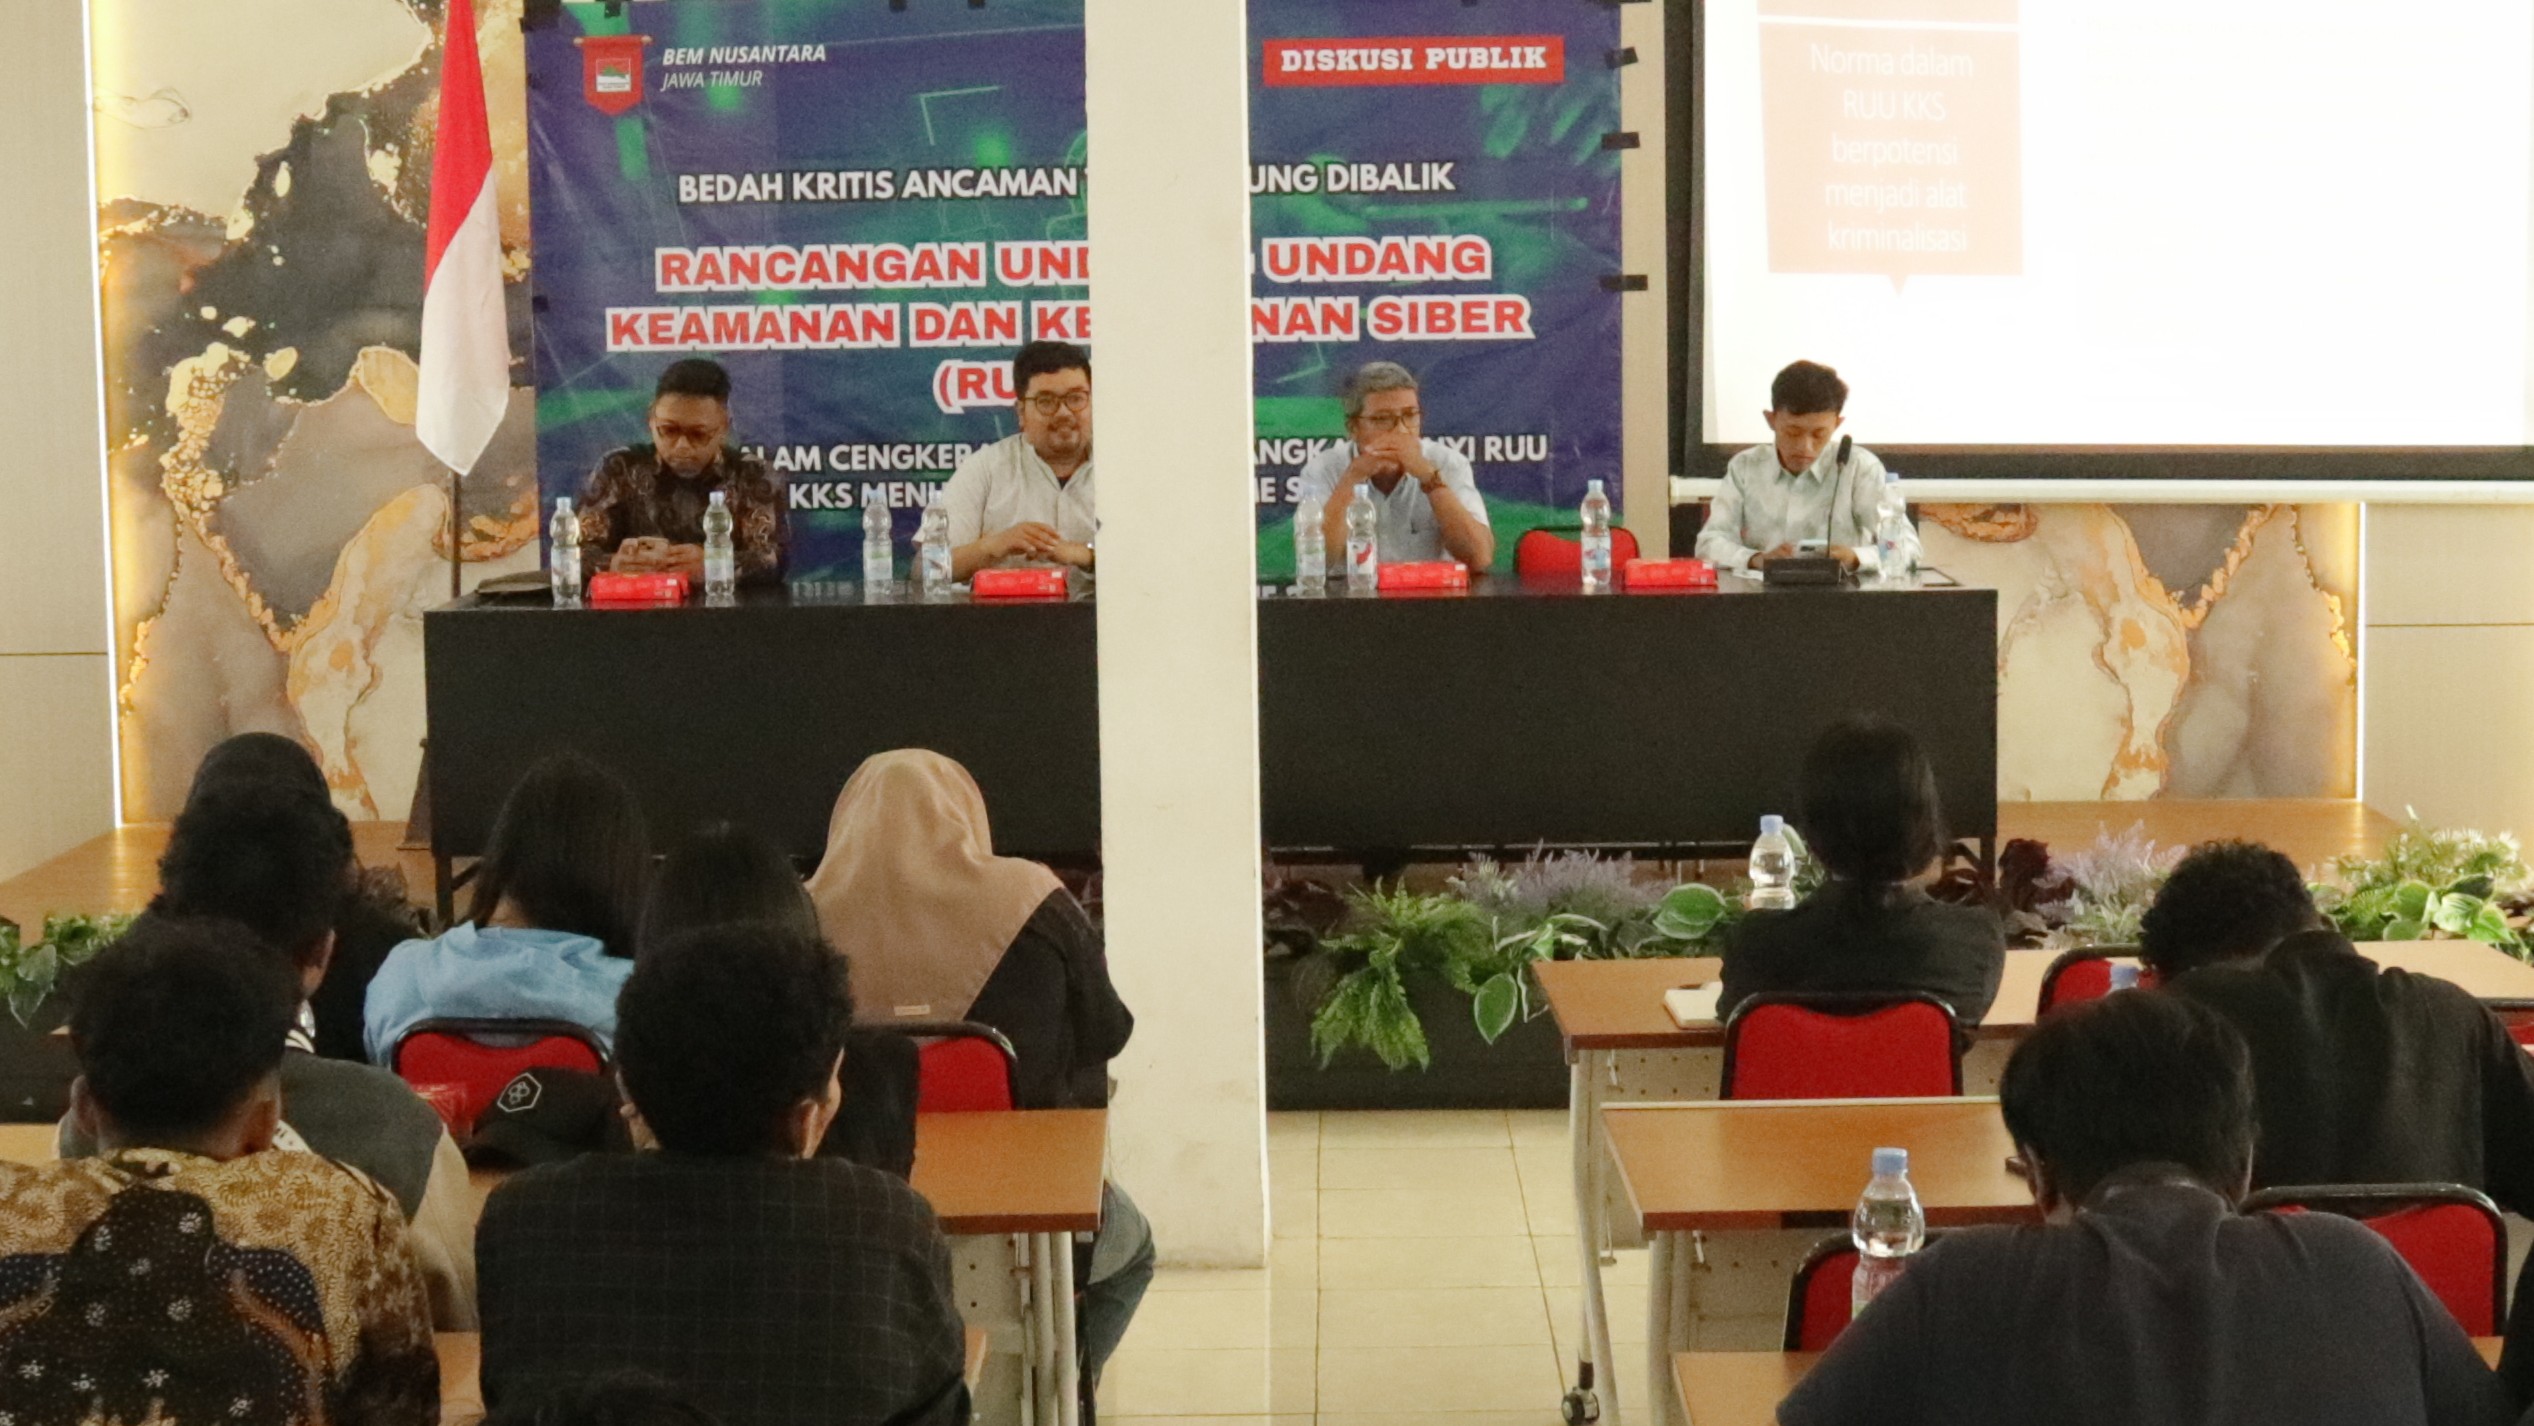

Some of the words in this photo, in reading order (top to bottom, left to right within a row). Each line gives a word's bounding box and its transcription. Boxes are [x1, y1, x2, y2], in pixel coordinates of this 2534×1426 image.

[662, 47, 705, 66] BEM
[708, 44, 827, 64] NUSANTARA
[1280, 47, 1414, 73] DISKUSI
[1425, 45, 1547, 71] PUBLIK
[1810, 43, 1895, 76] Norma
[1900, 45, 1975, 77] dalam
[659, 71, 705, 92] JAWA
[709, 69, 763, 87] TIMUR
[1842, 88, 1897, 120] RUU
[1903, 90, 1948, 122] KKS
[1831, 131, 1959, 169] berpotensi
[678, 172, 784, 203] BEDAH
[792, 169, 895, 201] KRITIS
[902, 167, 1078, 199] ANCAMAN
[1250, 163, 1319, 194] UNG
[1326, 161, 1456, 193] DIBALIK
[1824, 177, 1920, 213] menjadi
[1926, 179, 1969, 209] alat
[1827, 219, 1968, 251] kriminalisasi
[660, 244, 982, 287] RANCANGAN
[1267, 239, 1487, 279] UNDANG
[611, 307, 896, 347] KEAMANAN
[914, 304, 1018, 343] DAN
[1036, 304, 1091, 341] KE
[1251, 301, 1355, 338] NAN
[1373, 298, 1526, 337] SIBER
[938, 364, 1018, 407] (RU
[1483, 435, 1548, 462] RUU
[788, 482, 854, 510] KKS
